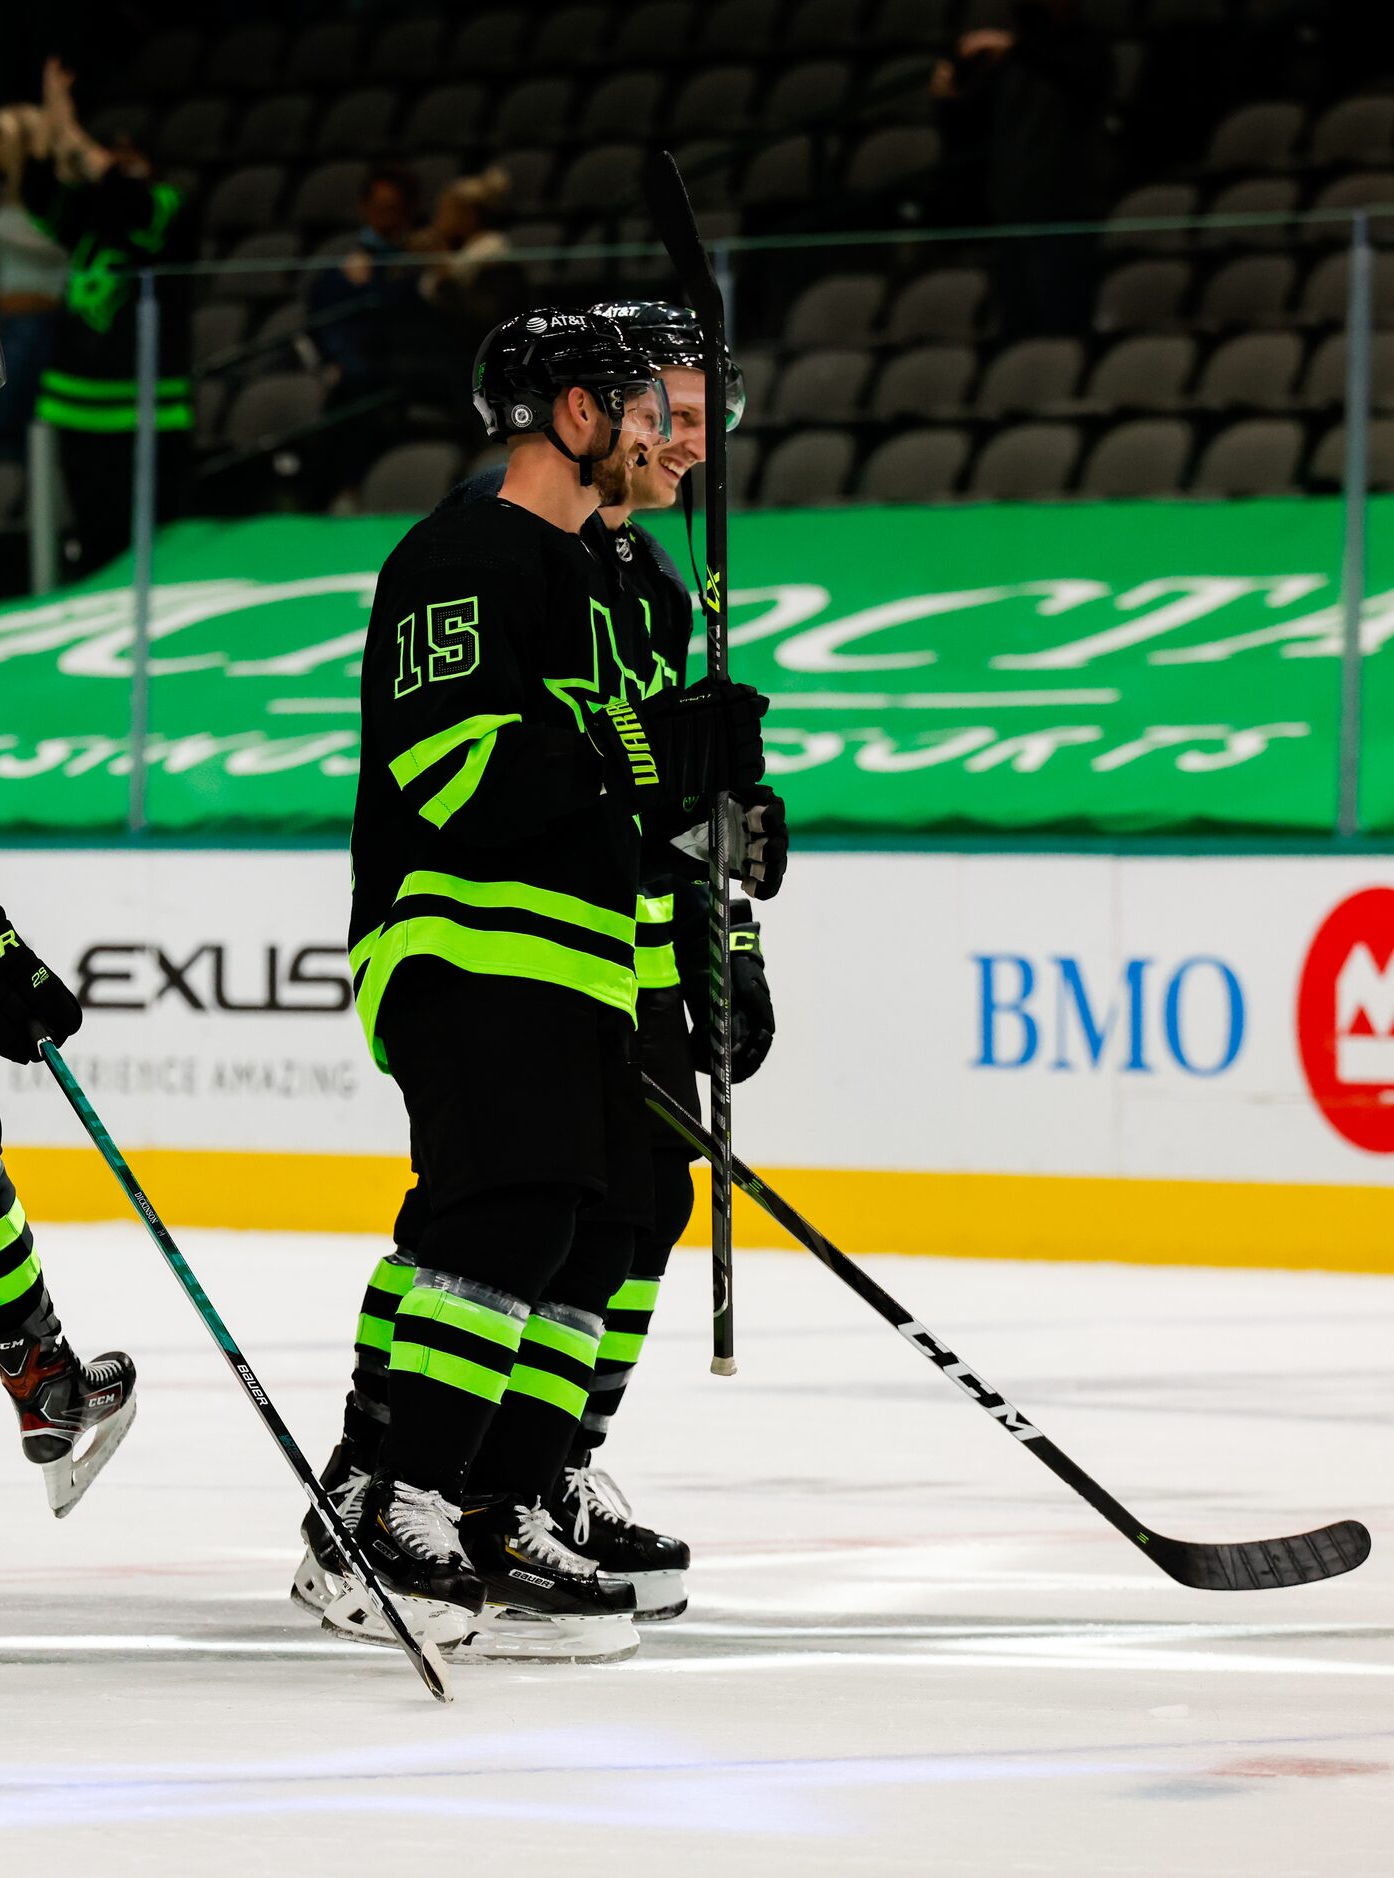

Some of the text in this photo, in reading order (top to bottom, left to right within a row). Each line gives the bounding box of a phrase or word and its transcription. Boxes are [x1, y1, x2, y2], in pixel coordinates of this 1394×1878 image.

[551, 315, 586, 328] AT&T
[602, 306, 640, 319] AT&T
[394, 595, 480, 700] 15
[74, 944, 352, 1013] EXUS
[969, 952, 1247, 1077] BMO
[134, 1191, 159, 1225] DICKINSON
[88, 1393, 115, 1408] CCM
[898, 1319, 1045, 1443] CCM
